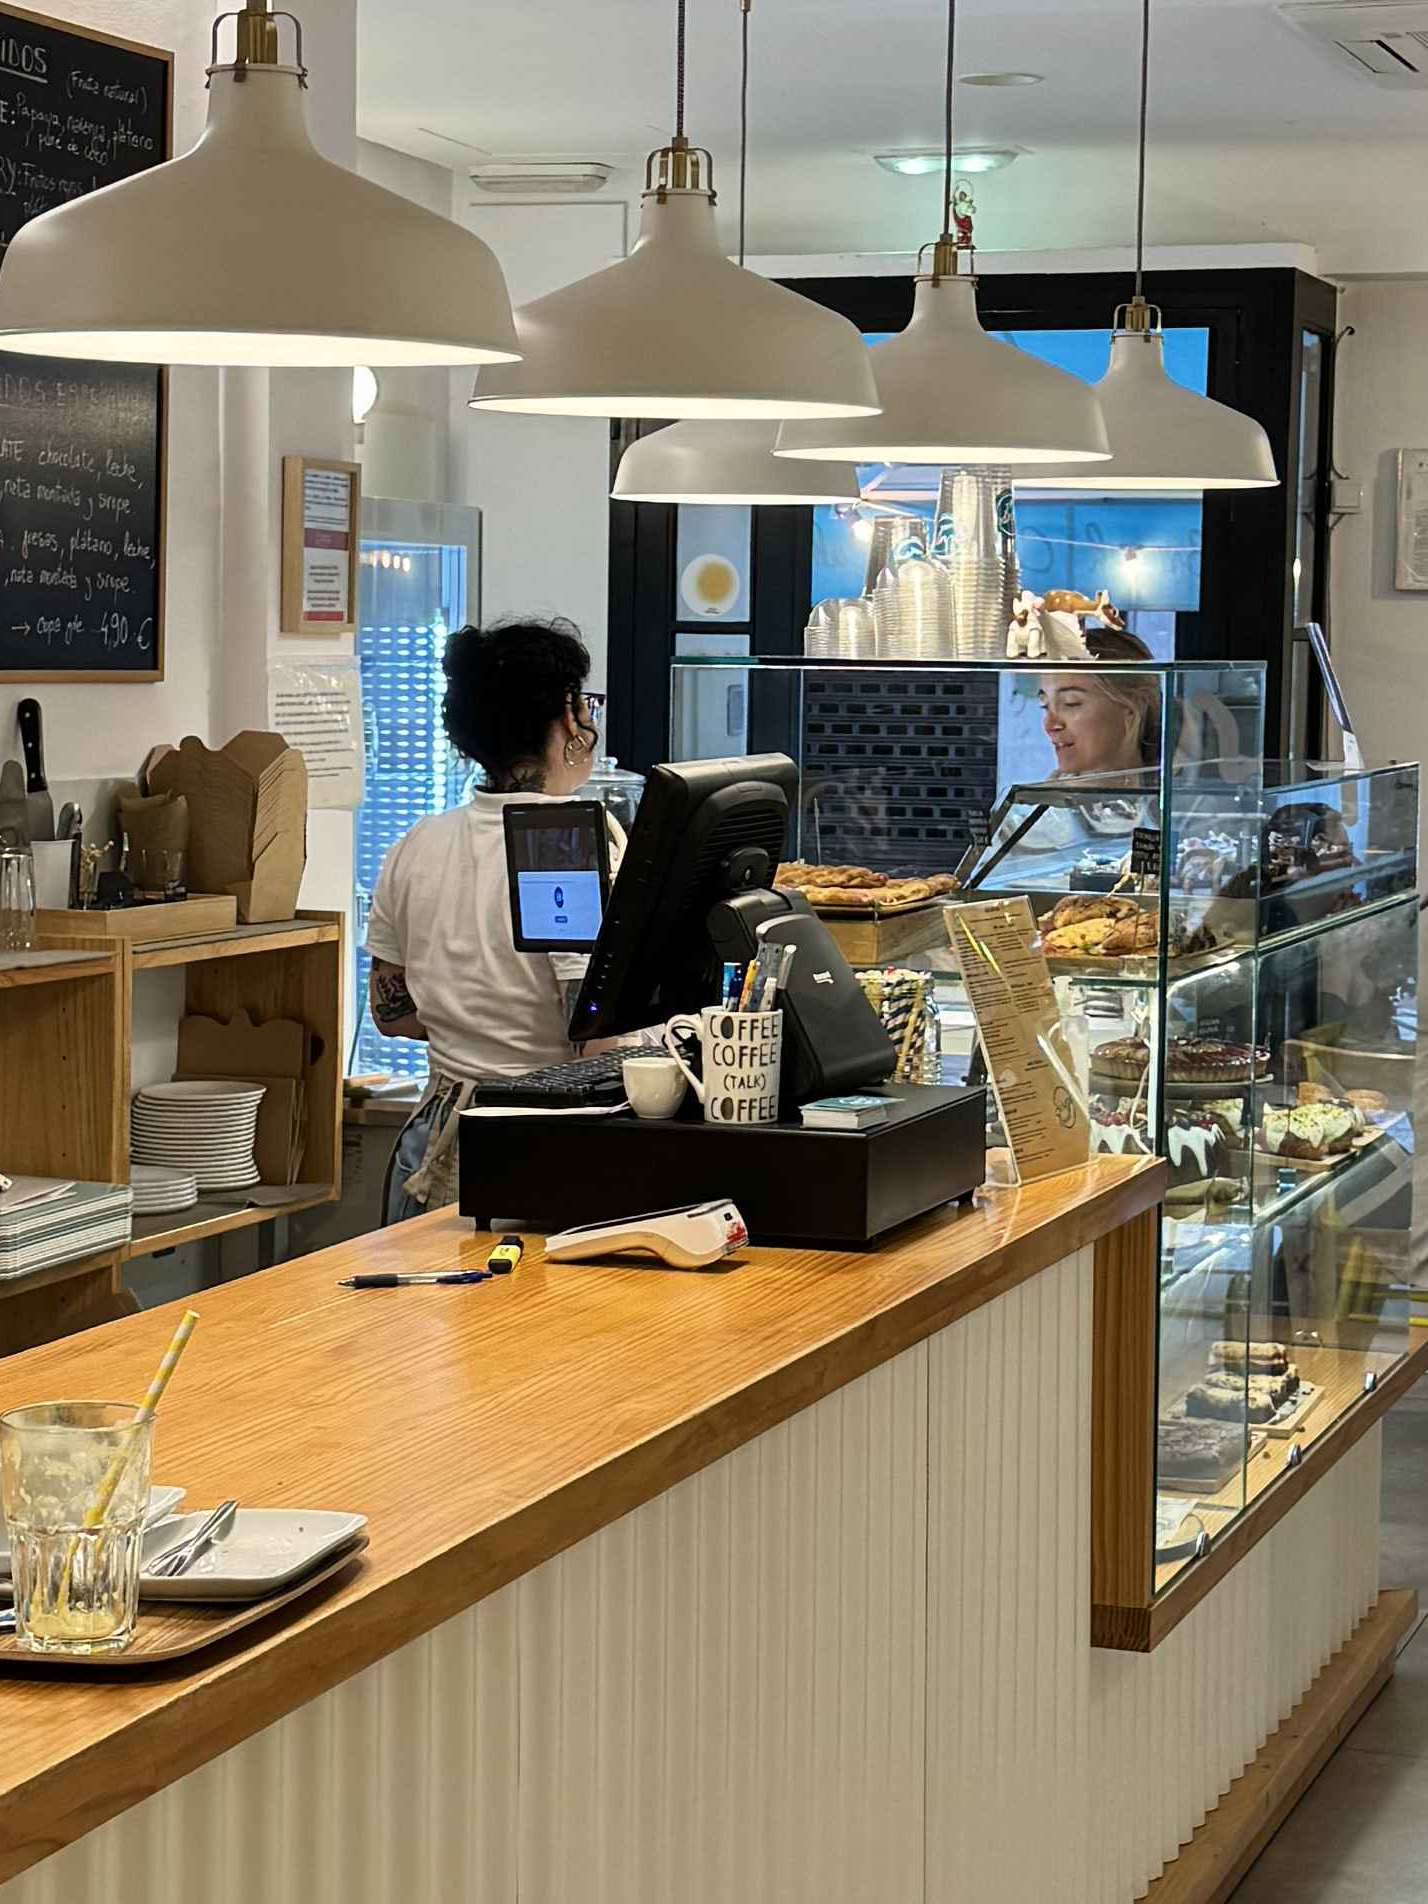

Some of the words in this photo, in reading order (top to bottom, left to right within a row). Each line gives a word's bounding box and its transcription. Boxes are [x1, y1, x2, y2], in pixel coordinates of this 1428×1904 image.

[710, 1015, 779, 1042] COFFEE
[712, 1042, 777, 1069] COFFEE
[723, 1073, 766, 1092] (TALK)
[711, 1095, 776, 1122] COFFEE
